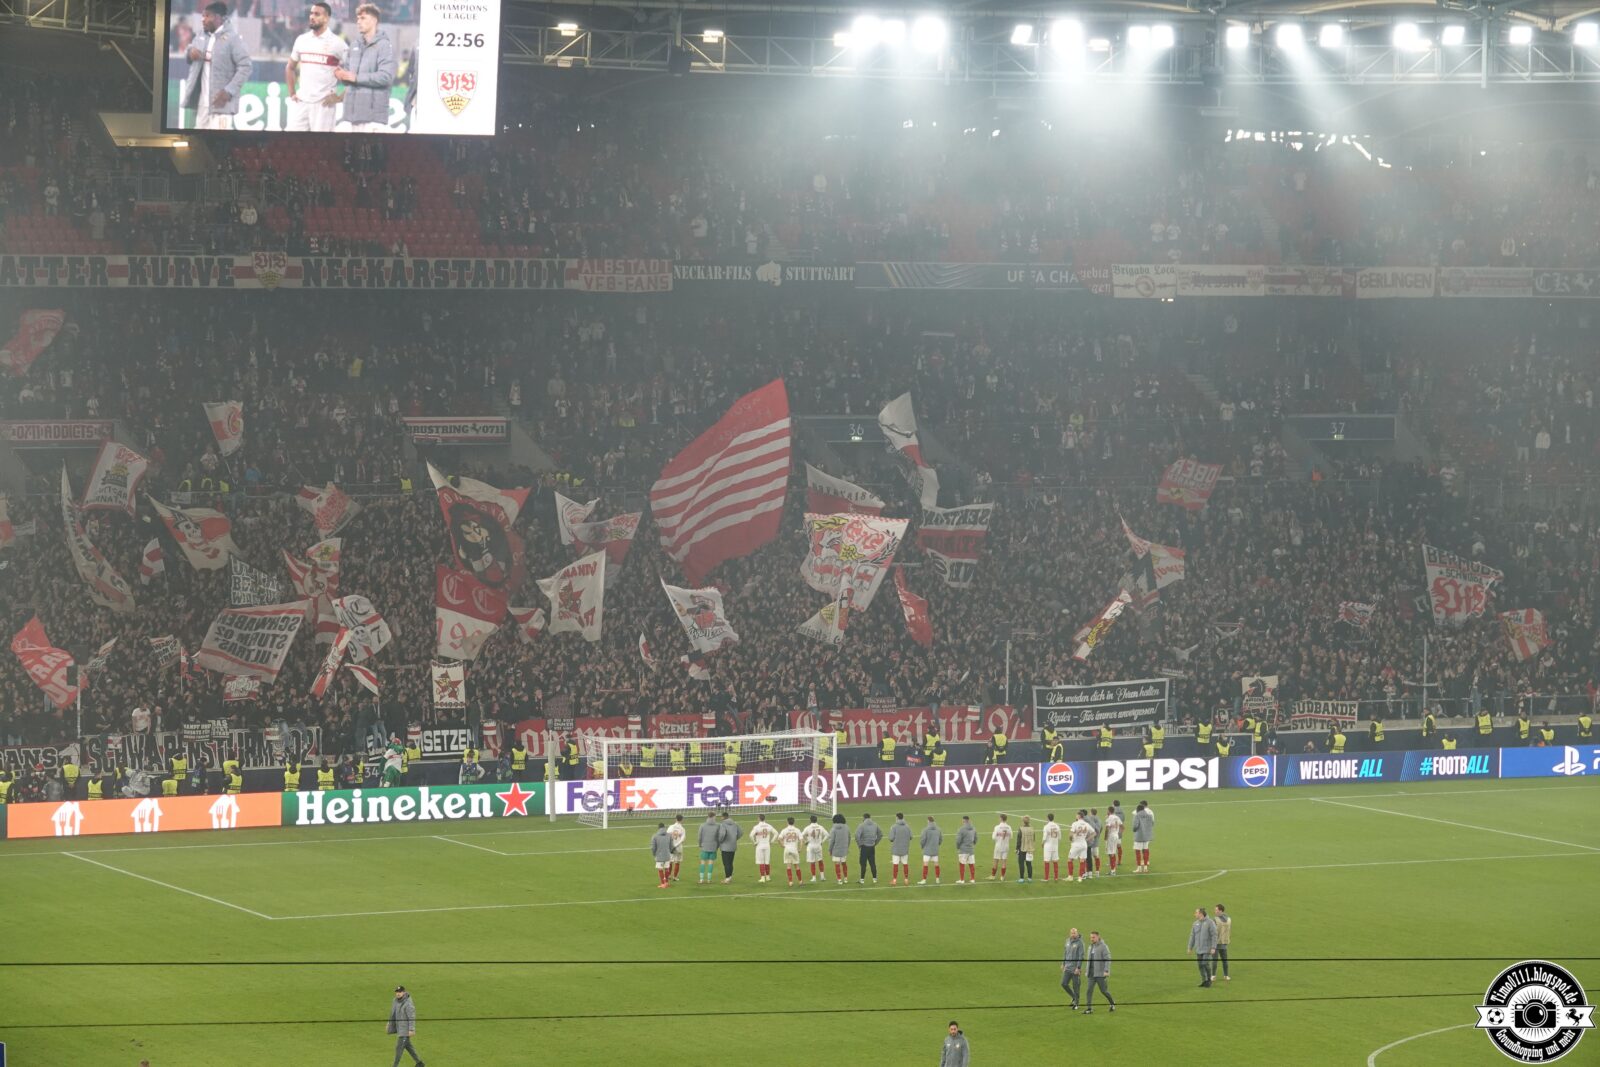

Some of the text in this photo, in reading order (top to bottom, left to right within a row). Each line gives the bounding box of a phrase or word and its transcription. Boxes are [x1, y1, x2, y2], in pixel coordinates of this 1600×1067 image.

[433, 4, 488, 12] CHAMPIONS
[434, 32, 485, 48] 22:56
[0, 255, 566, 288] ATTER KURVE NECKARSTADION
[580, 259, 671, 274] ALBSTADT
[785, 266, 856, 281] STUTTGART
[1049, 270, 1080, 284] CHA
[1358, 272, 1432, 289] GERLINGEN
[403, 424, 470, 434] RUSTRING
[848, 423, 865, 437] 36
[1330, 421, 1346, 435] 37
[1046, 691, 1064, 705] Wir
[1064, 691, 1089, 703] werden
[1090, 689, 1106, 701] dich
[1106, 690, 1114, 700] in
[659, 721, 690, 735] SZENE
[1291, 718, 1357, 731] STUTTGRT
[0, 747, 59, 773] ANS
[1419, 755, 1490, 777] #FOOTBALL
[364, 767, 380, 779] 34
[1097, 757, 1219, 793] PEPSI
[1243, 766, 1268, 776] PEPSI
[1299, 758, 1383, 781] WELCOME ALL
[803, 766, 1036, 804] QATAR AIRWAYS
[1047, 774, 1073, 782] PEPSI
[566, 779, 659, 813] FedEx
[687, 774, 778, 807] FedEx
[295, 786, 494, 825] Heineken
[810, 828, 821, 840] 47
